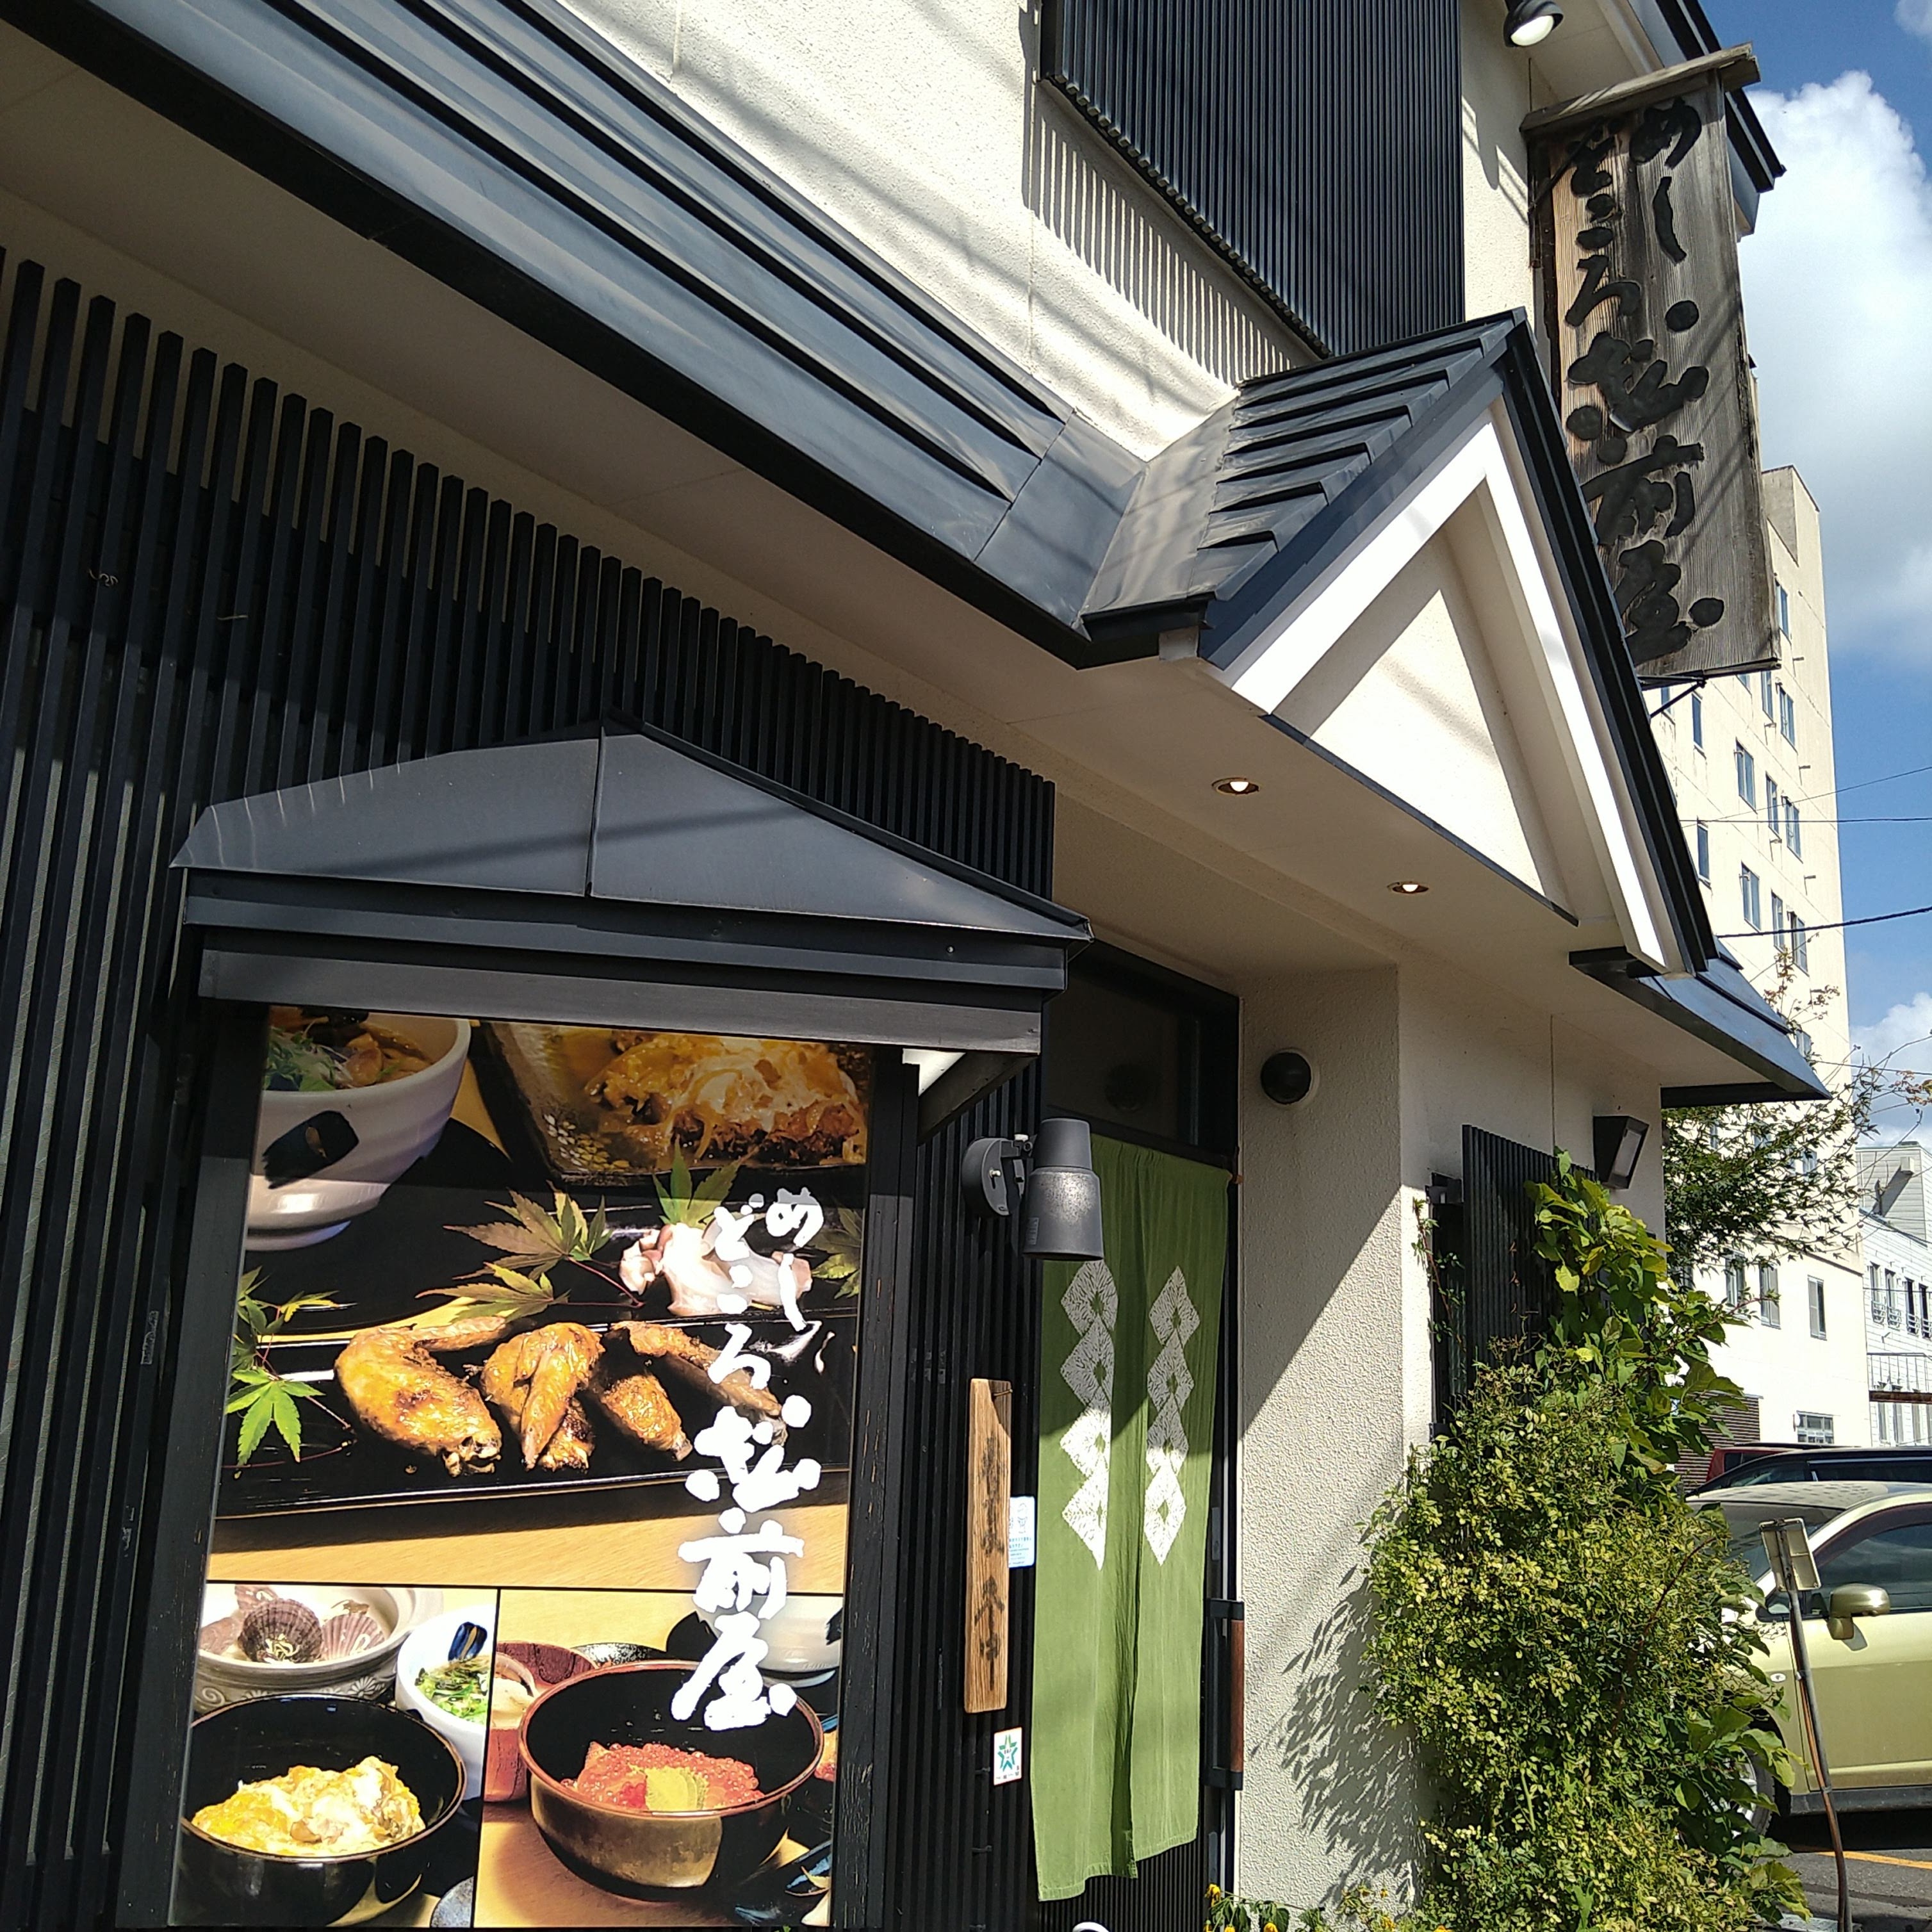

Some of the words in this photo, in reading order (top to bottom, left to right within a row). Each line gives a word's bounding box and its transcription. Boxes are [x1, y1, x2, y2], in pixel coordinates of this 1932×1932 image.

[1565, 115, 1641, 327] どころ
[1629, 97, 1702, 266] めし
[707, 1193, 771, 1390] どころ
[765, 1187, 824, 1332] めし
